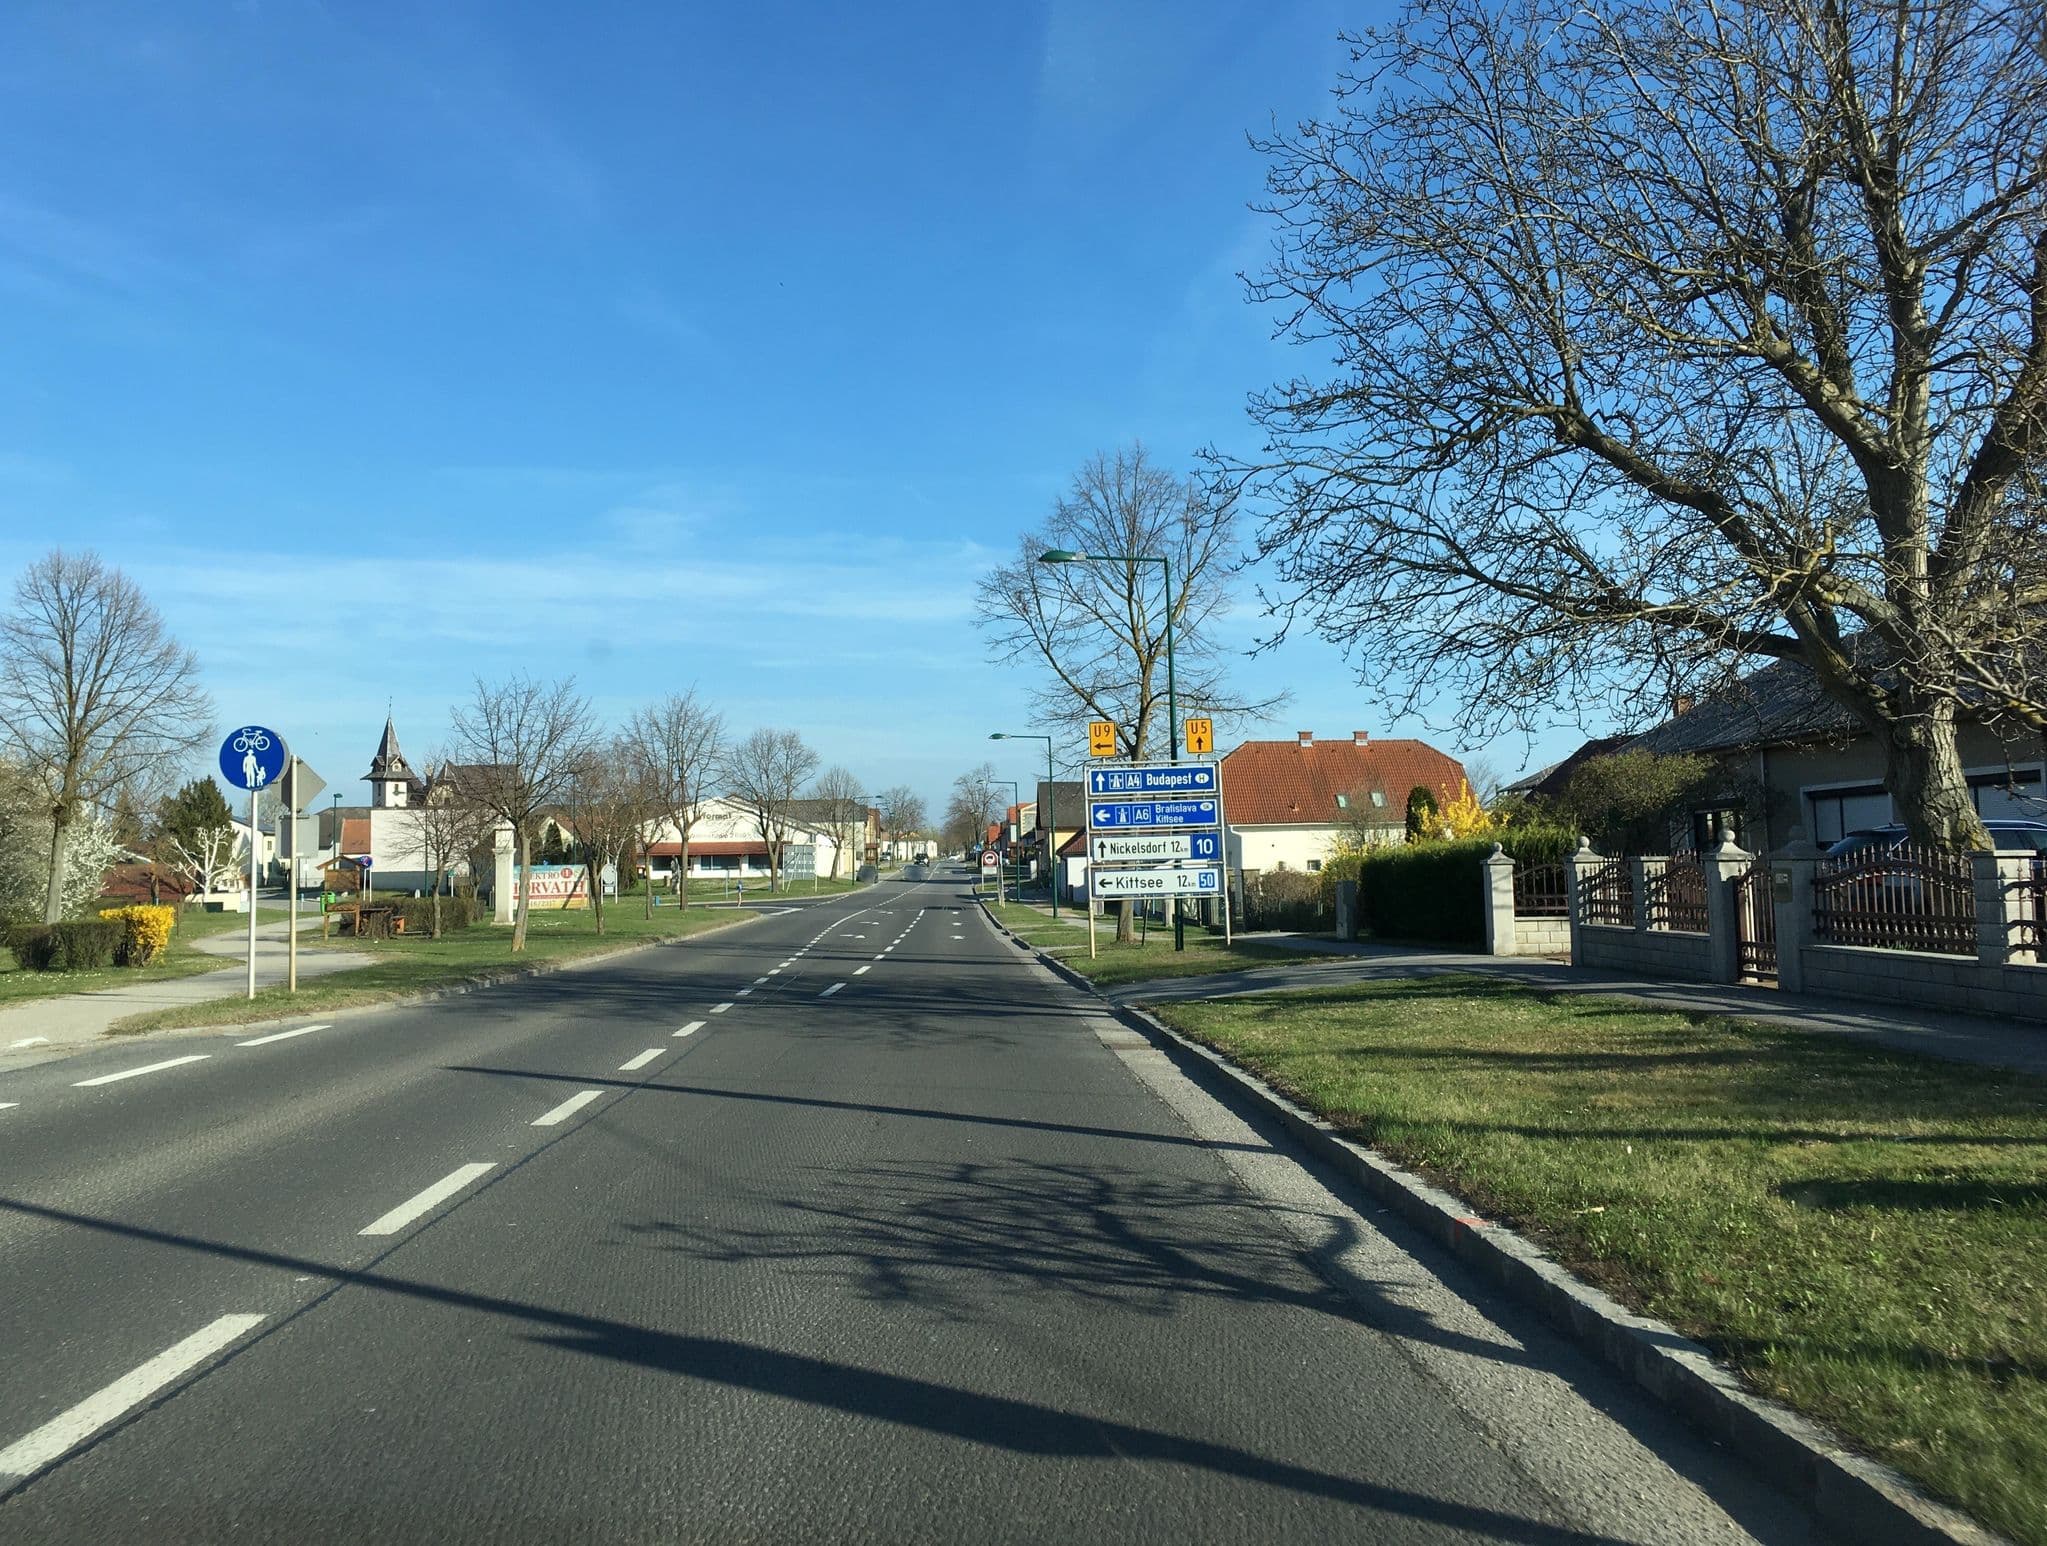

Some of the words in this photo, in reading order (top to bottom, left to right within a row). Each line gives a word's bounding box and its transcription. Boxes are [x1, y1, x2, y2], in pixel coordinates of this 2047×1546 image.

[1127, 774, 1140, 787] A4
[1146, 773, 1192, 788] Budapest
[1135, 809, 1149, 821] A6
[1155, 803, 1197, 814] Bratislava
[1156, 815, 1184, 824] Kittsee
[1110, 841, 1166, 854] Nickelsdorf
[1196, 838, 1213, 854] 10
[1116, 876, 1164, 889] Kittsee
[1200, 874, 1213, 887] 50
